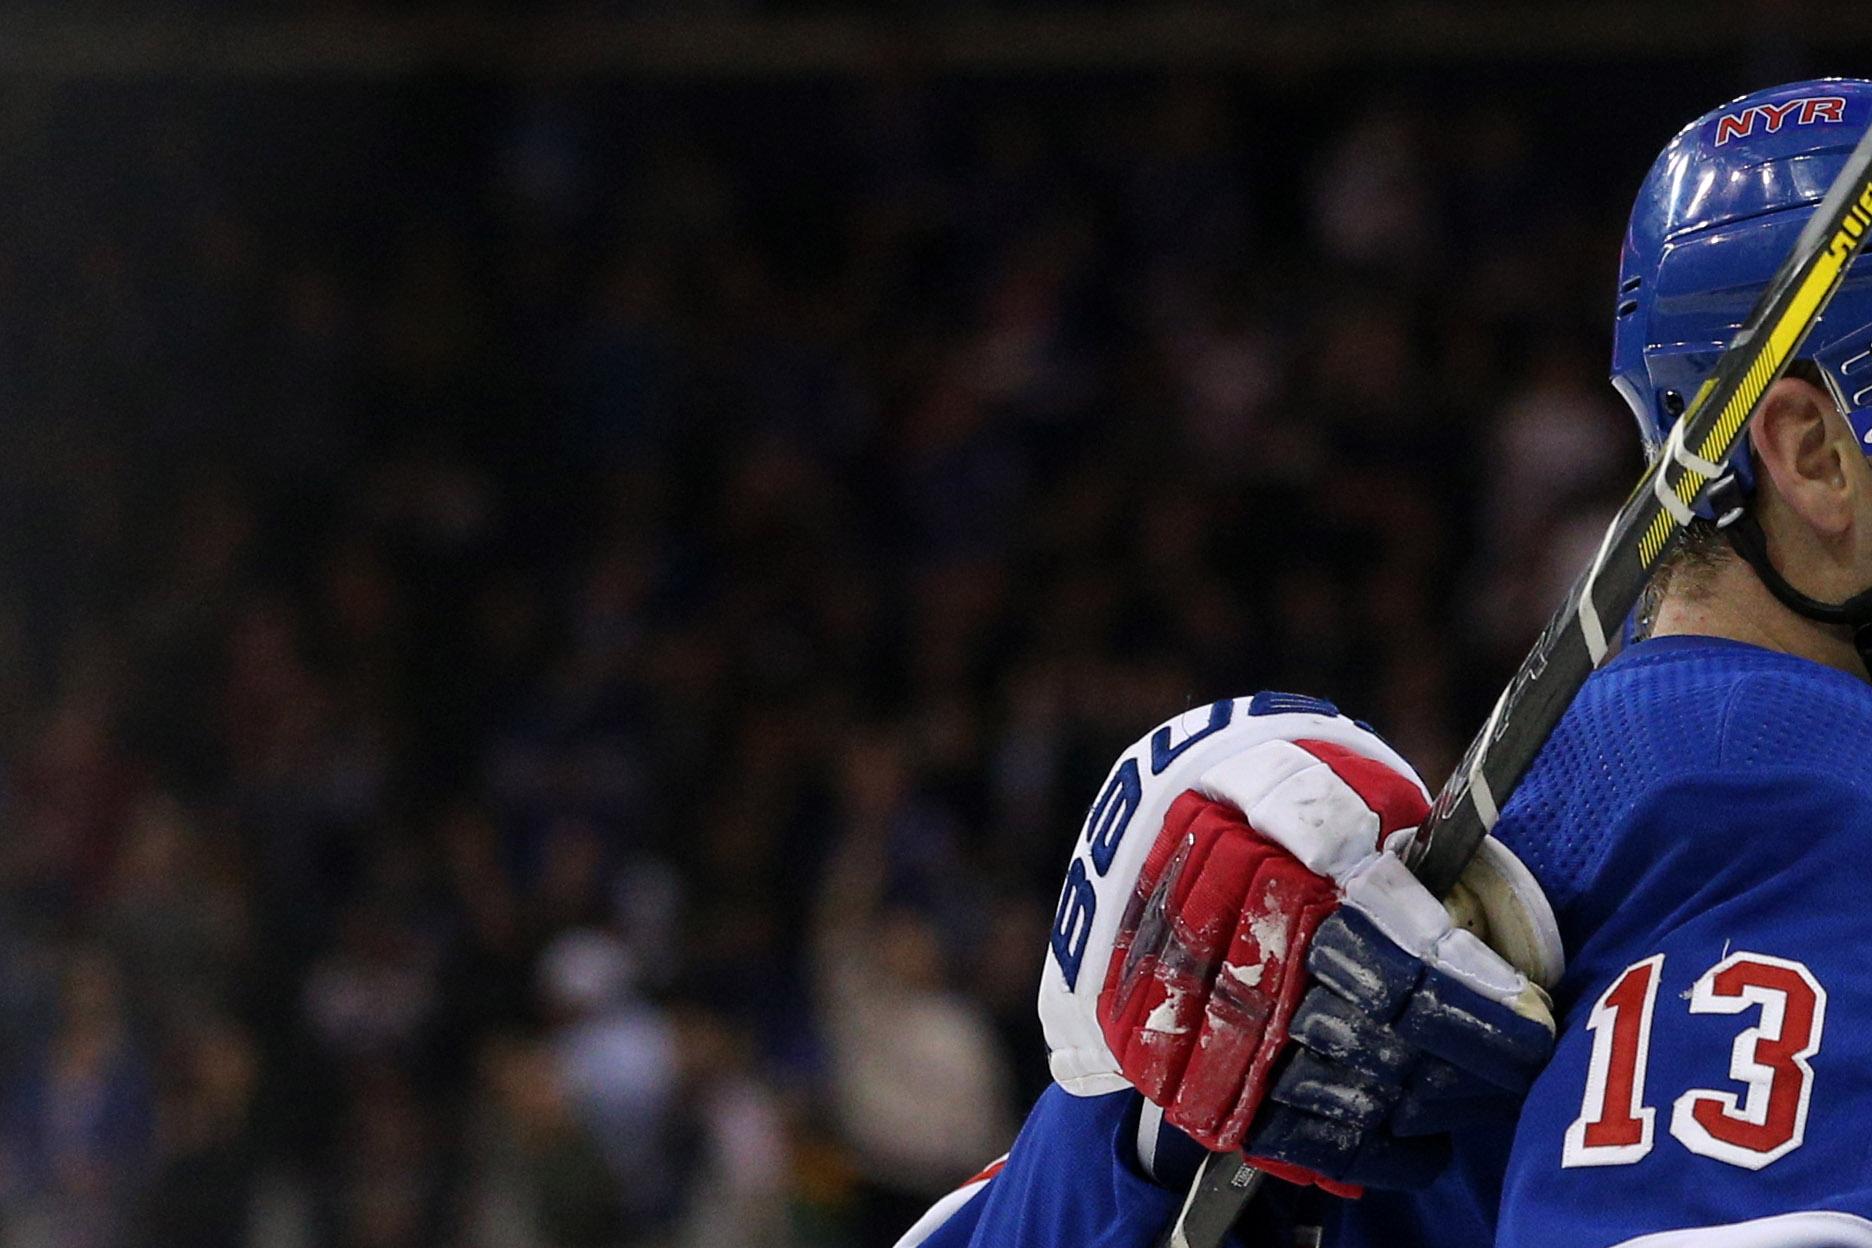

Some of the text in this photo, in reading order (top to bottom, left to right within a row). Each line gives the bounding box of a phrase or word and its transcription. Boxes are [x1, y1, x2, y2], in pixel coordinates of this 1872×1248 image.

[1714, 96, 1846, 148] NYR
[1051, 690, 1376, 993] BAUE
[1561, 949, 1828, 1171] 13
